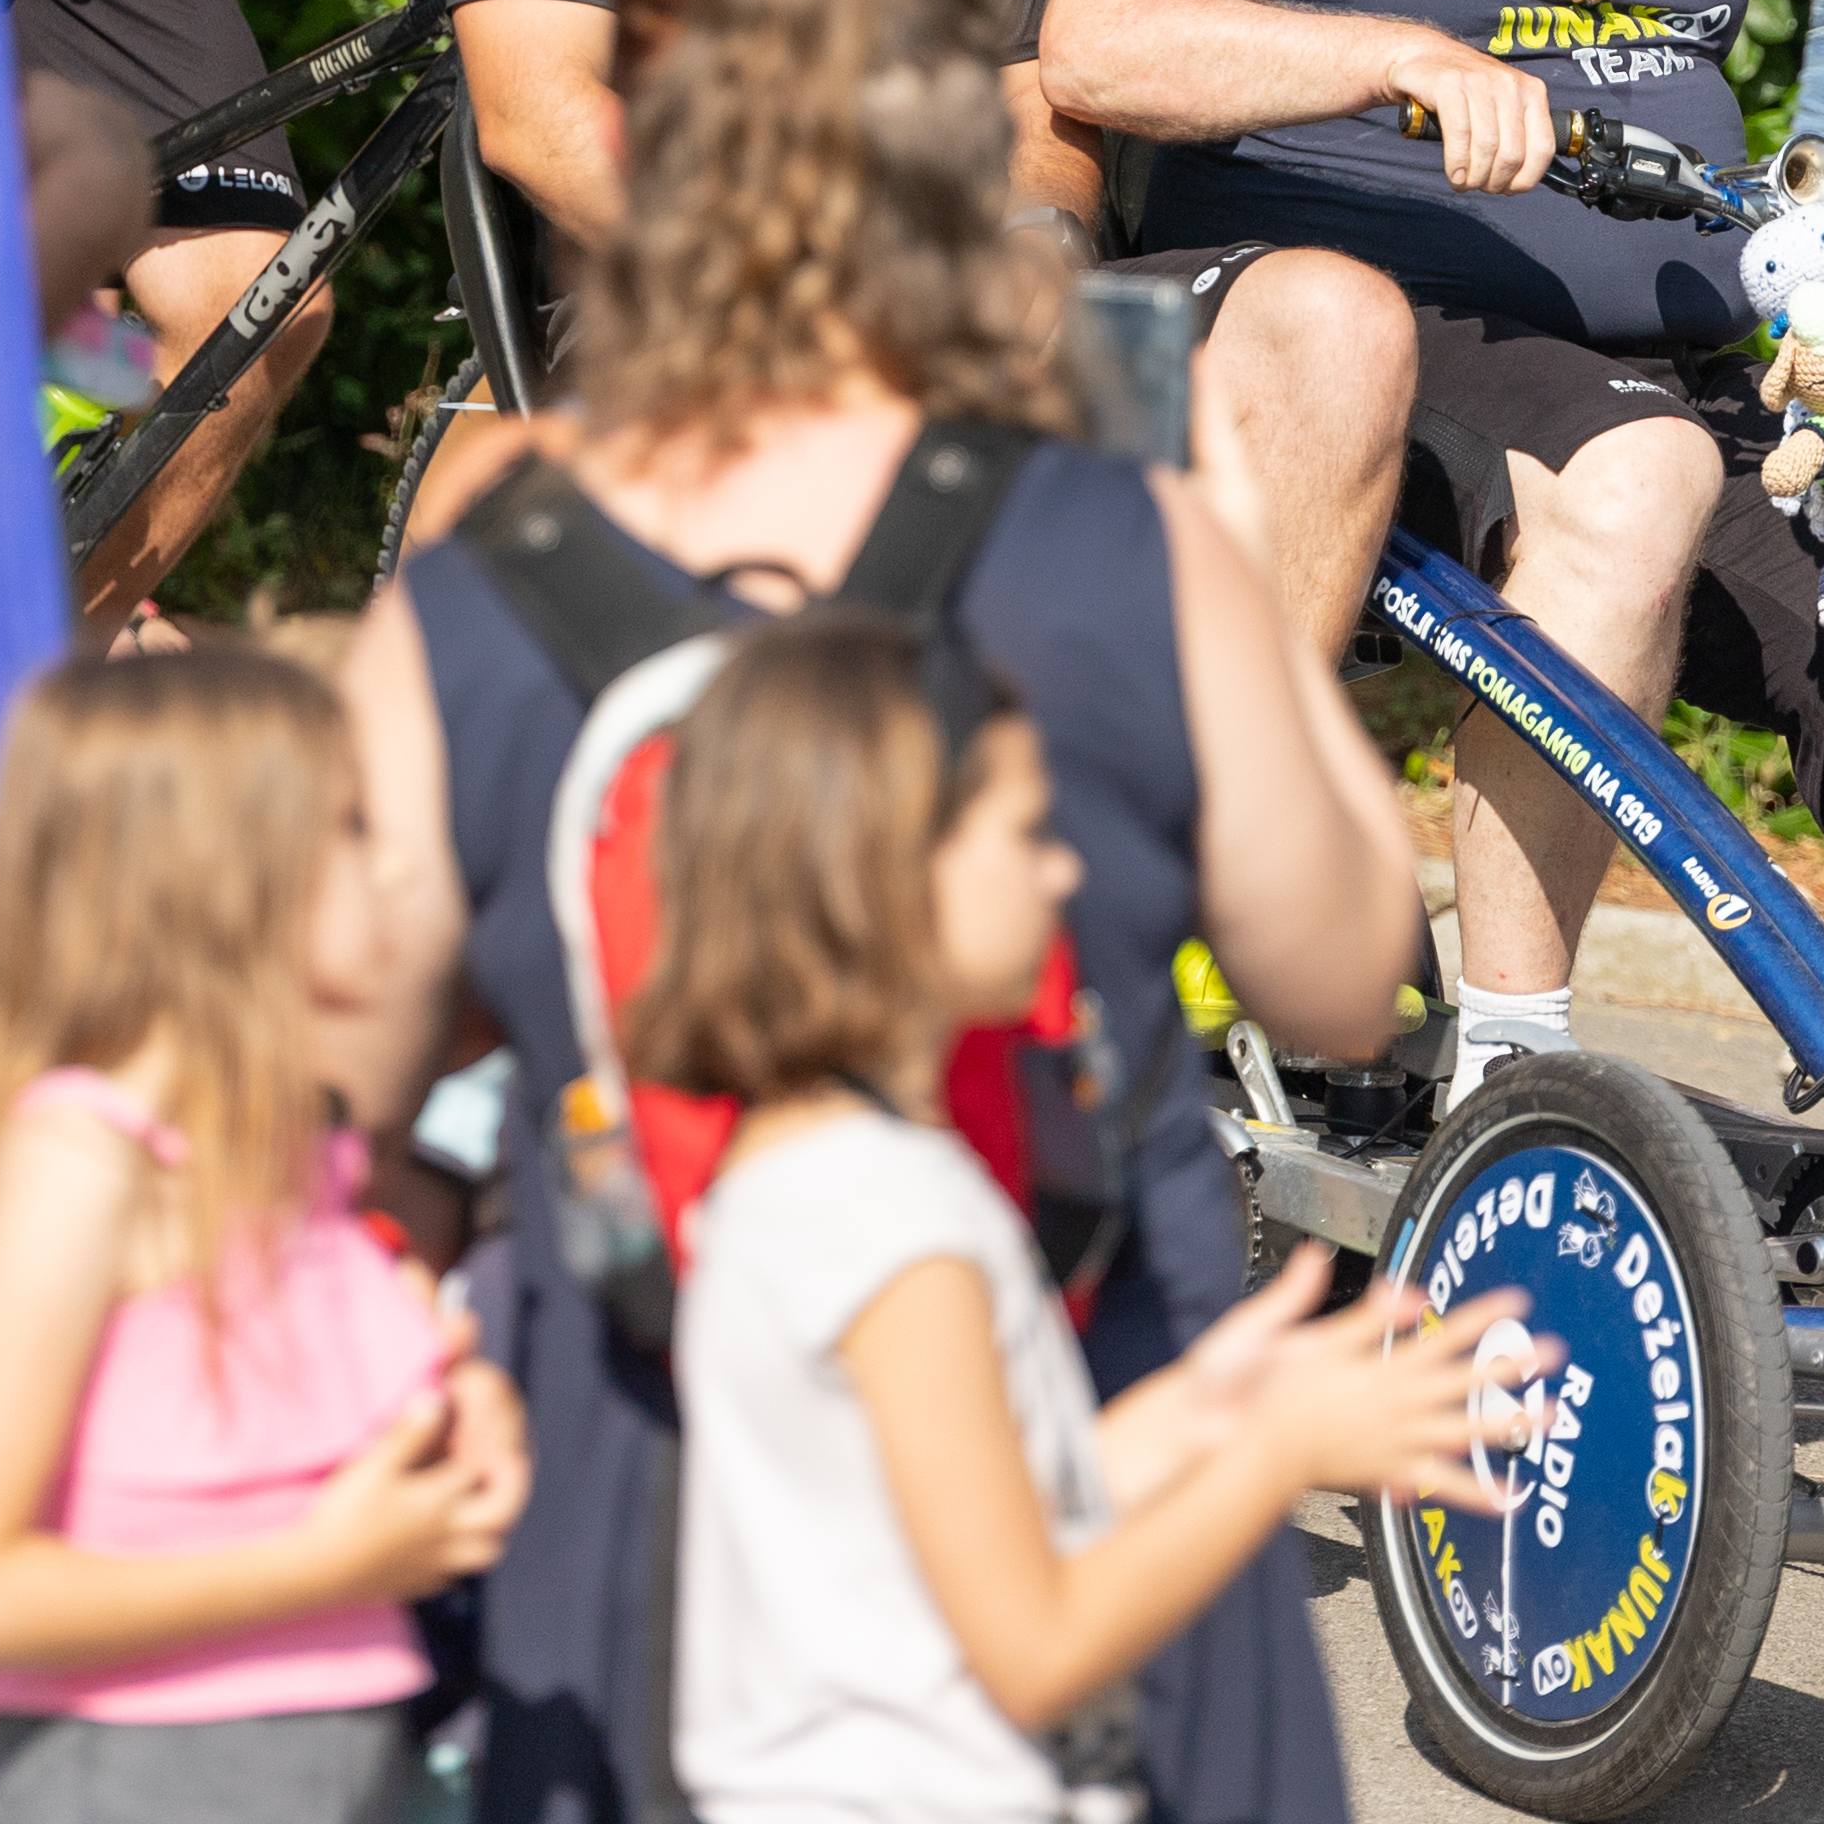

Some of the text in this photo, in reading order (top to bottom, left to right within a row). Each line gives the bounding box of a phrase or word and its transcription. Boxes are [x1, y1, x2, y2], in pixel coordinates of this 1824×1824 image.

[309, 35, 373, 84] BIGWIG
[218, 166, 293, 196] LELOSI
[228, 179, 355, 340] ragley
[1467, 655, 1591, 775] POMAGAM10
[1583, 762, 1620, 808] NA
[1615, 793, 1663, 846] 1919
[1682, 856, 1720, 898] RADIO
[1536, 1363, 1595, 1549] RADIO
[1532, 1534, 1672, 1696] JUNAKOV
